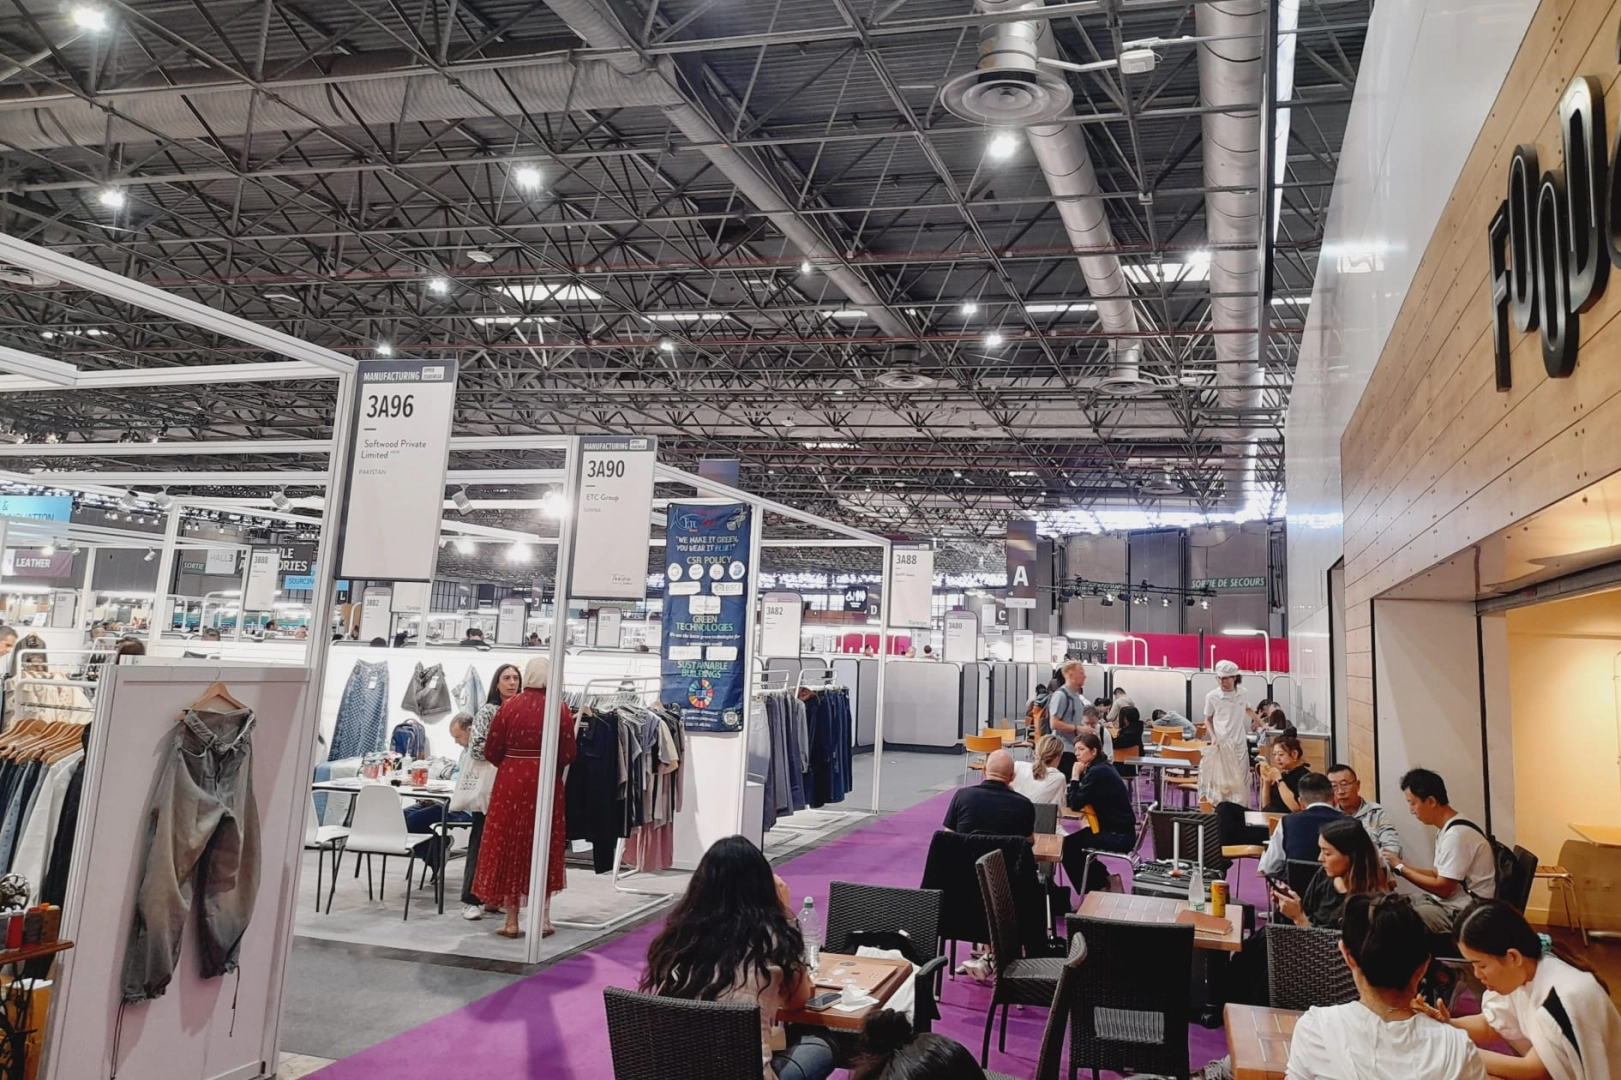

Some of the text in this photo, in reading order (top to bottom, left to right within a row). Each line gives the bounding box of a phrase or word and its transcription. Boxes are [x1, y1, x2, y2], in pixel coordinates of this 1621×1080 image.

[363, 370, 420, 381] MANUFACTURING
[366, 394, 415, 418] 3A96
[364, 439, 427, 448] Softwood Private
[583, 442, 629, 450] MANUFACTURING
[361, 450, 389, 459] Limited
[587, 460, 625, 478] 3A90
[586, 493, 620, 503] ETC Group
[676, 544, 689, 552] YOU
[15, 558, 51, 568] LEATHER
[686, 556, 732, 564] CSR POLICY
[895, 554, 917, 565] 3A88
[1012, 565, 1029, 587] A
[1217, 578, 1228, 588] DE
[1230, 577, 1265, 587] SECOURS
[460, 596, 466, 605] K
[534, 597, 540, 607] J
[765, 606, 784, 616] 3A82
[870, 604, 877, 615] D
[692, 615, 718, 624] GREEN
[998, 610, 1006, 620] C
[676, 622, 734, 632] TECHNOLOGIES
[677, 661, 728, 670] SUSTAINABLE
[681, 669, 721, 678] BUILDINGS
